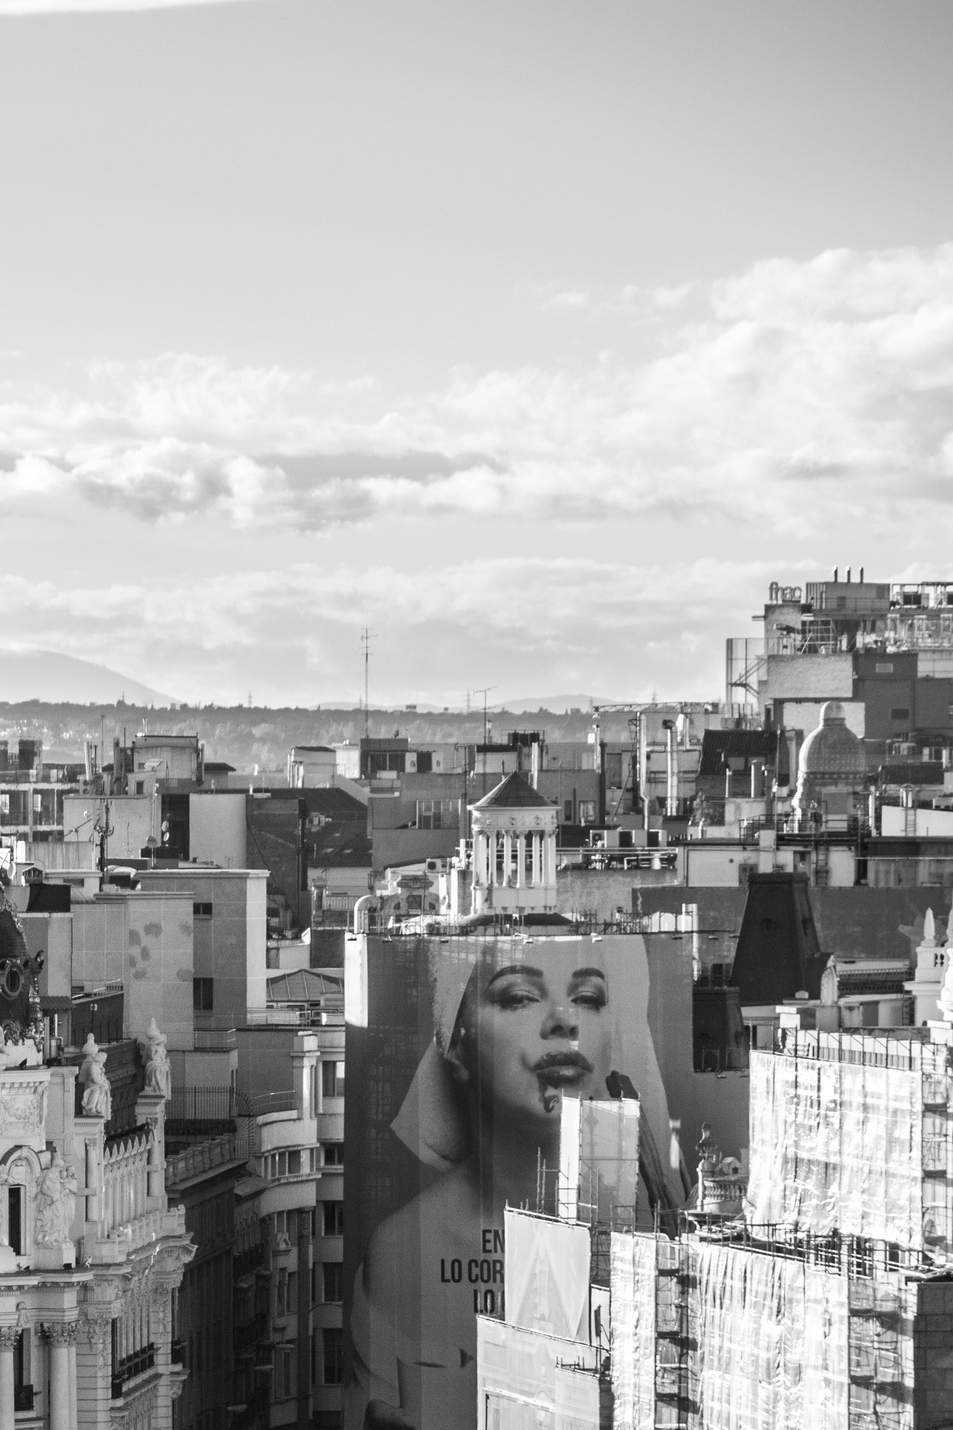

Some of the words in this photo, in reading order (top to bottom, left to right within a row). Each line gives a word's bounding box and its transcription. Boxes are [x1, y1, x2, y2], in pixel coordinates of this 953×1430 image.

[769, 581, 802, 602] fnac
[440, 1258, 462, 1284] LO
[473, 1289, 496, 1314] LO
